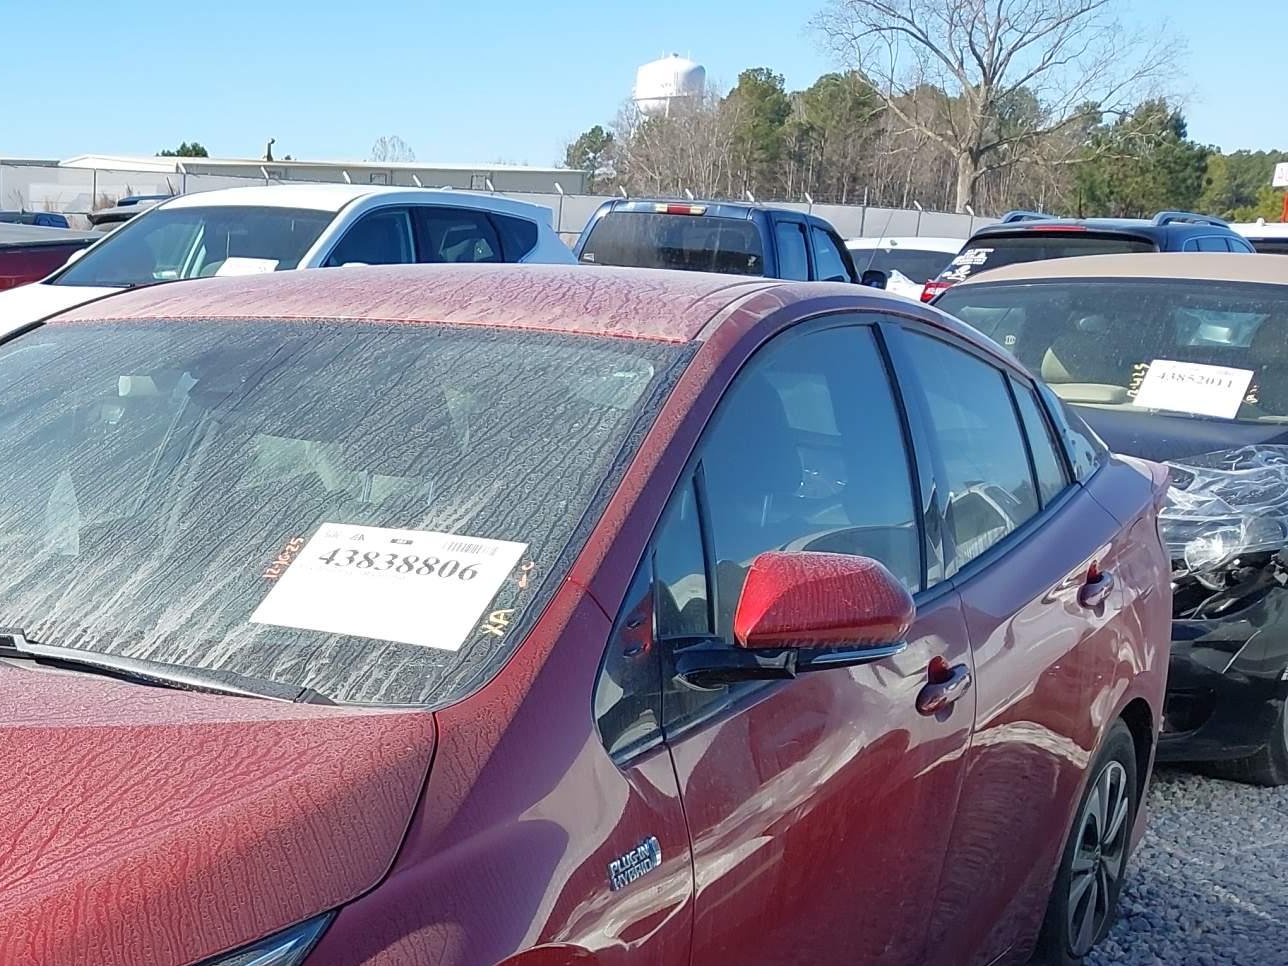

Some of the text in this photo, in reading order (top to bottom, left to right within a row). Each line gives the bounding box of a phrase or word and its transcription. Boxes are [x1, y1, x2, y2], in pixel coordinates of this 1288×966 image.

[318, 548, 482, 581] 43838806
[610, 842, 650, 878] PLUG-IN
[613, 859, 653, 890] HYBRID
